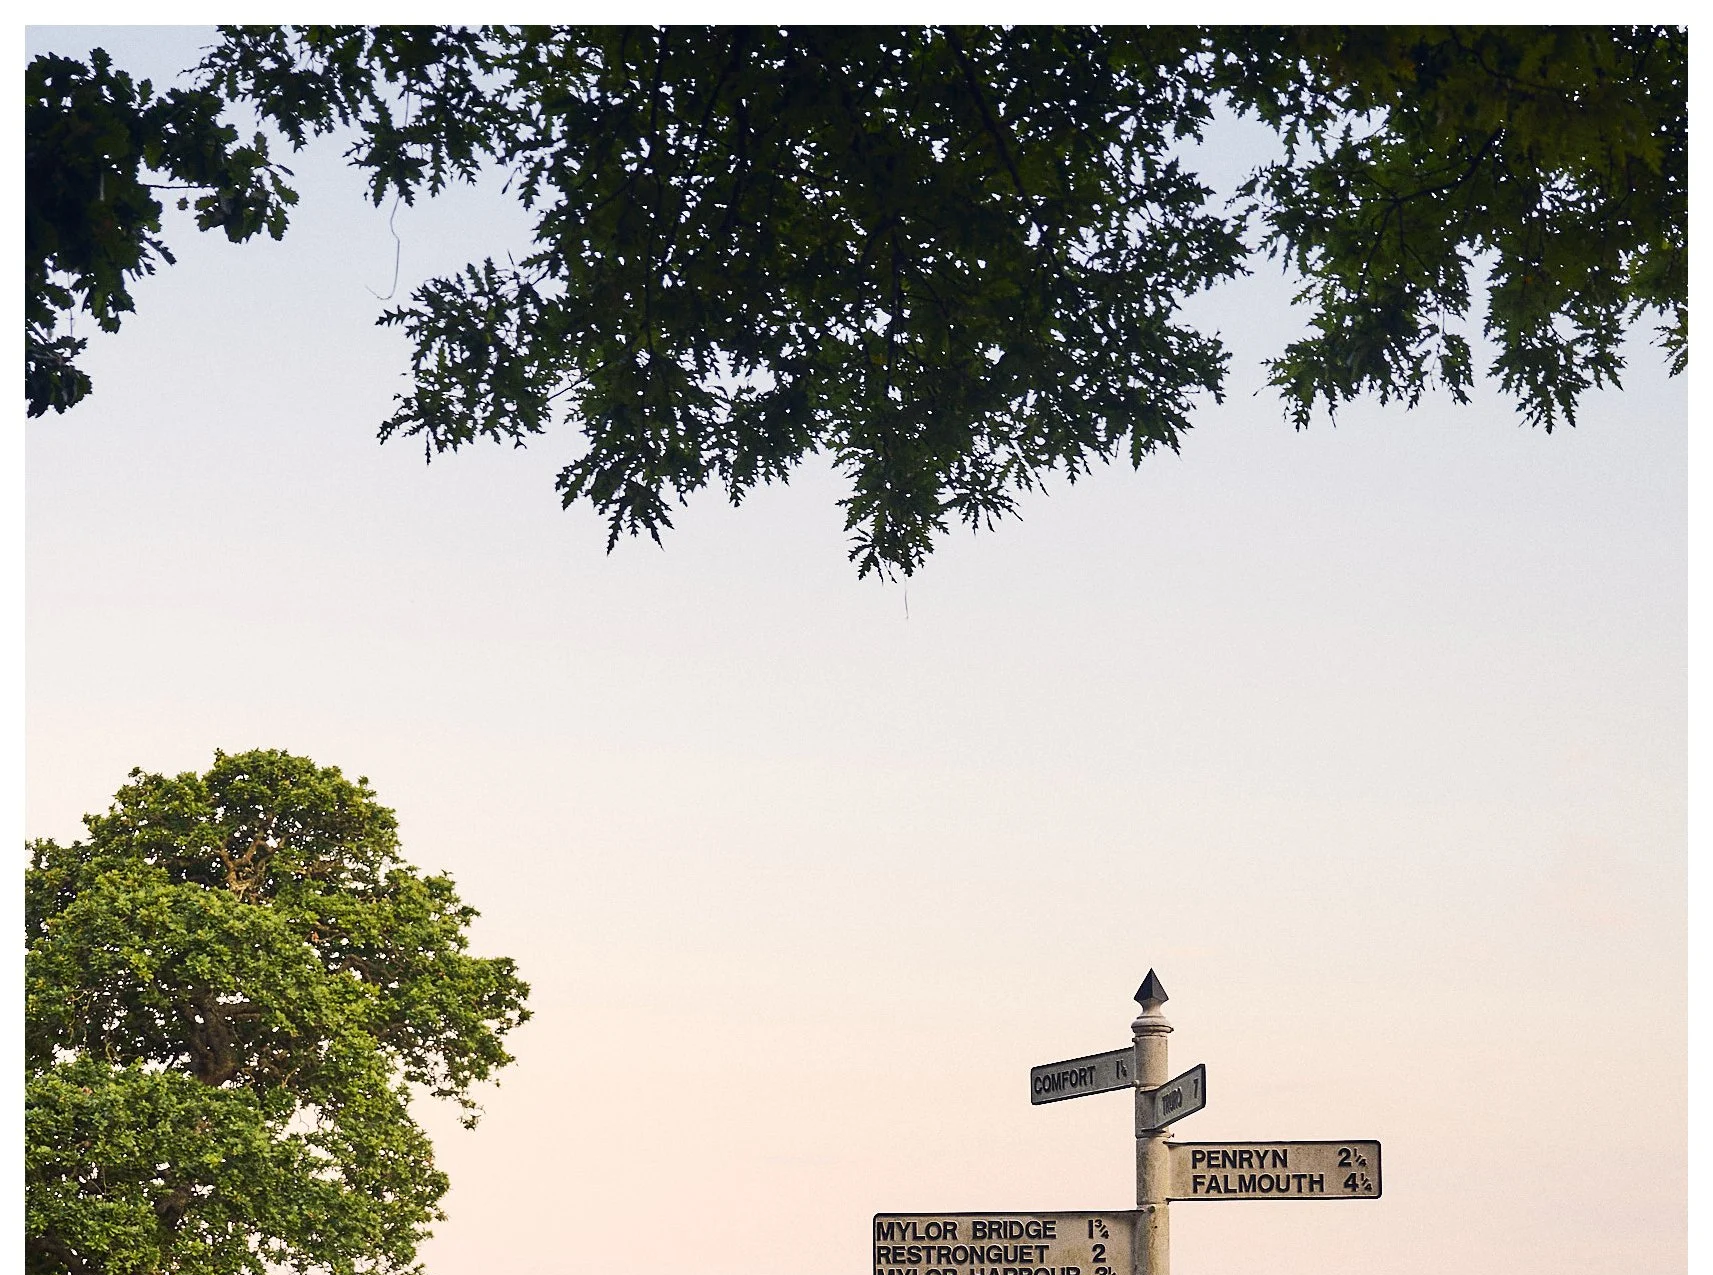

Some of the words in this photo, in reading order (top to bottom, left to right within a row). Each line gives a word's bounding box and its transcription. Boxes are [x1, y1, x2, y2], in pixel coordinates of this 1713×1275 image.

[1034, 1065, 1096, 1095] COMFORT
[1191, 1149, 1288, 1169] PENRYN
[1192, 1173, 1325, 1194] FALMOUTH
[876, 1220, 958, 1241] MYLOR
[972, 1220, 1057, 1240] BRIDGE
[876, 1244, 1050, 1265] RESTRONGUET
[1091, 1243, 1107, 1263] 2
